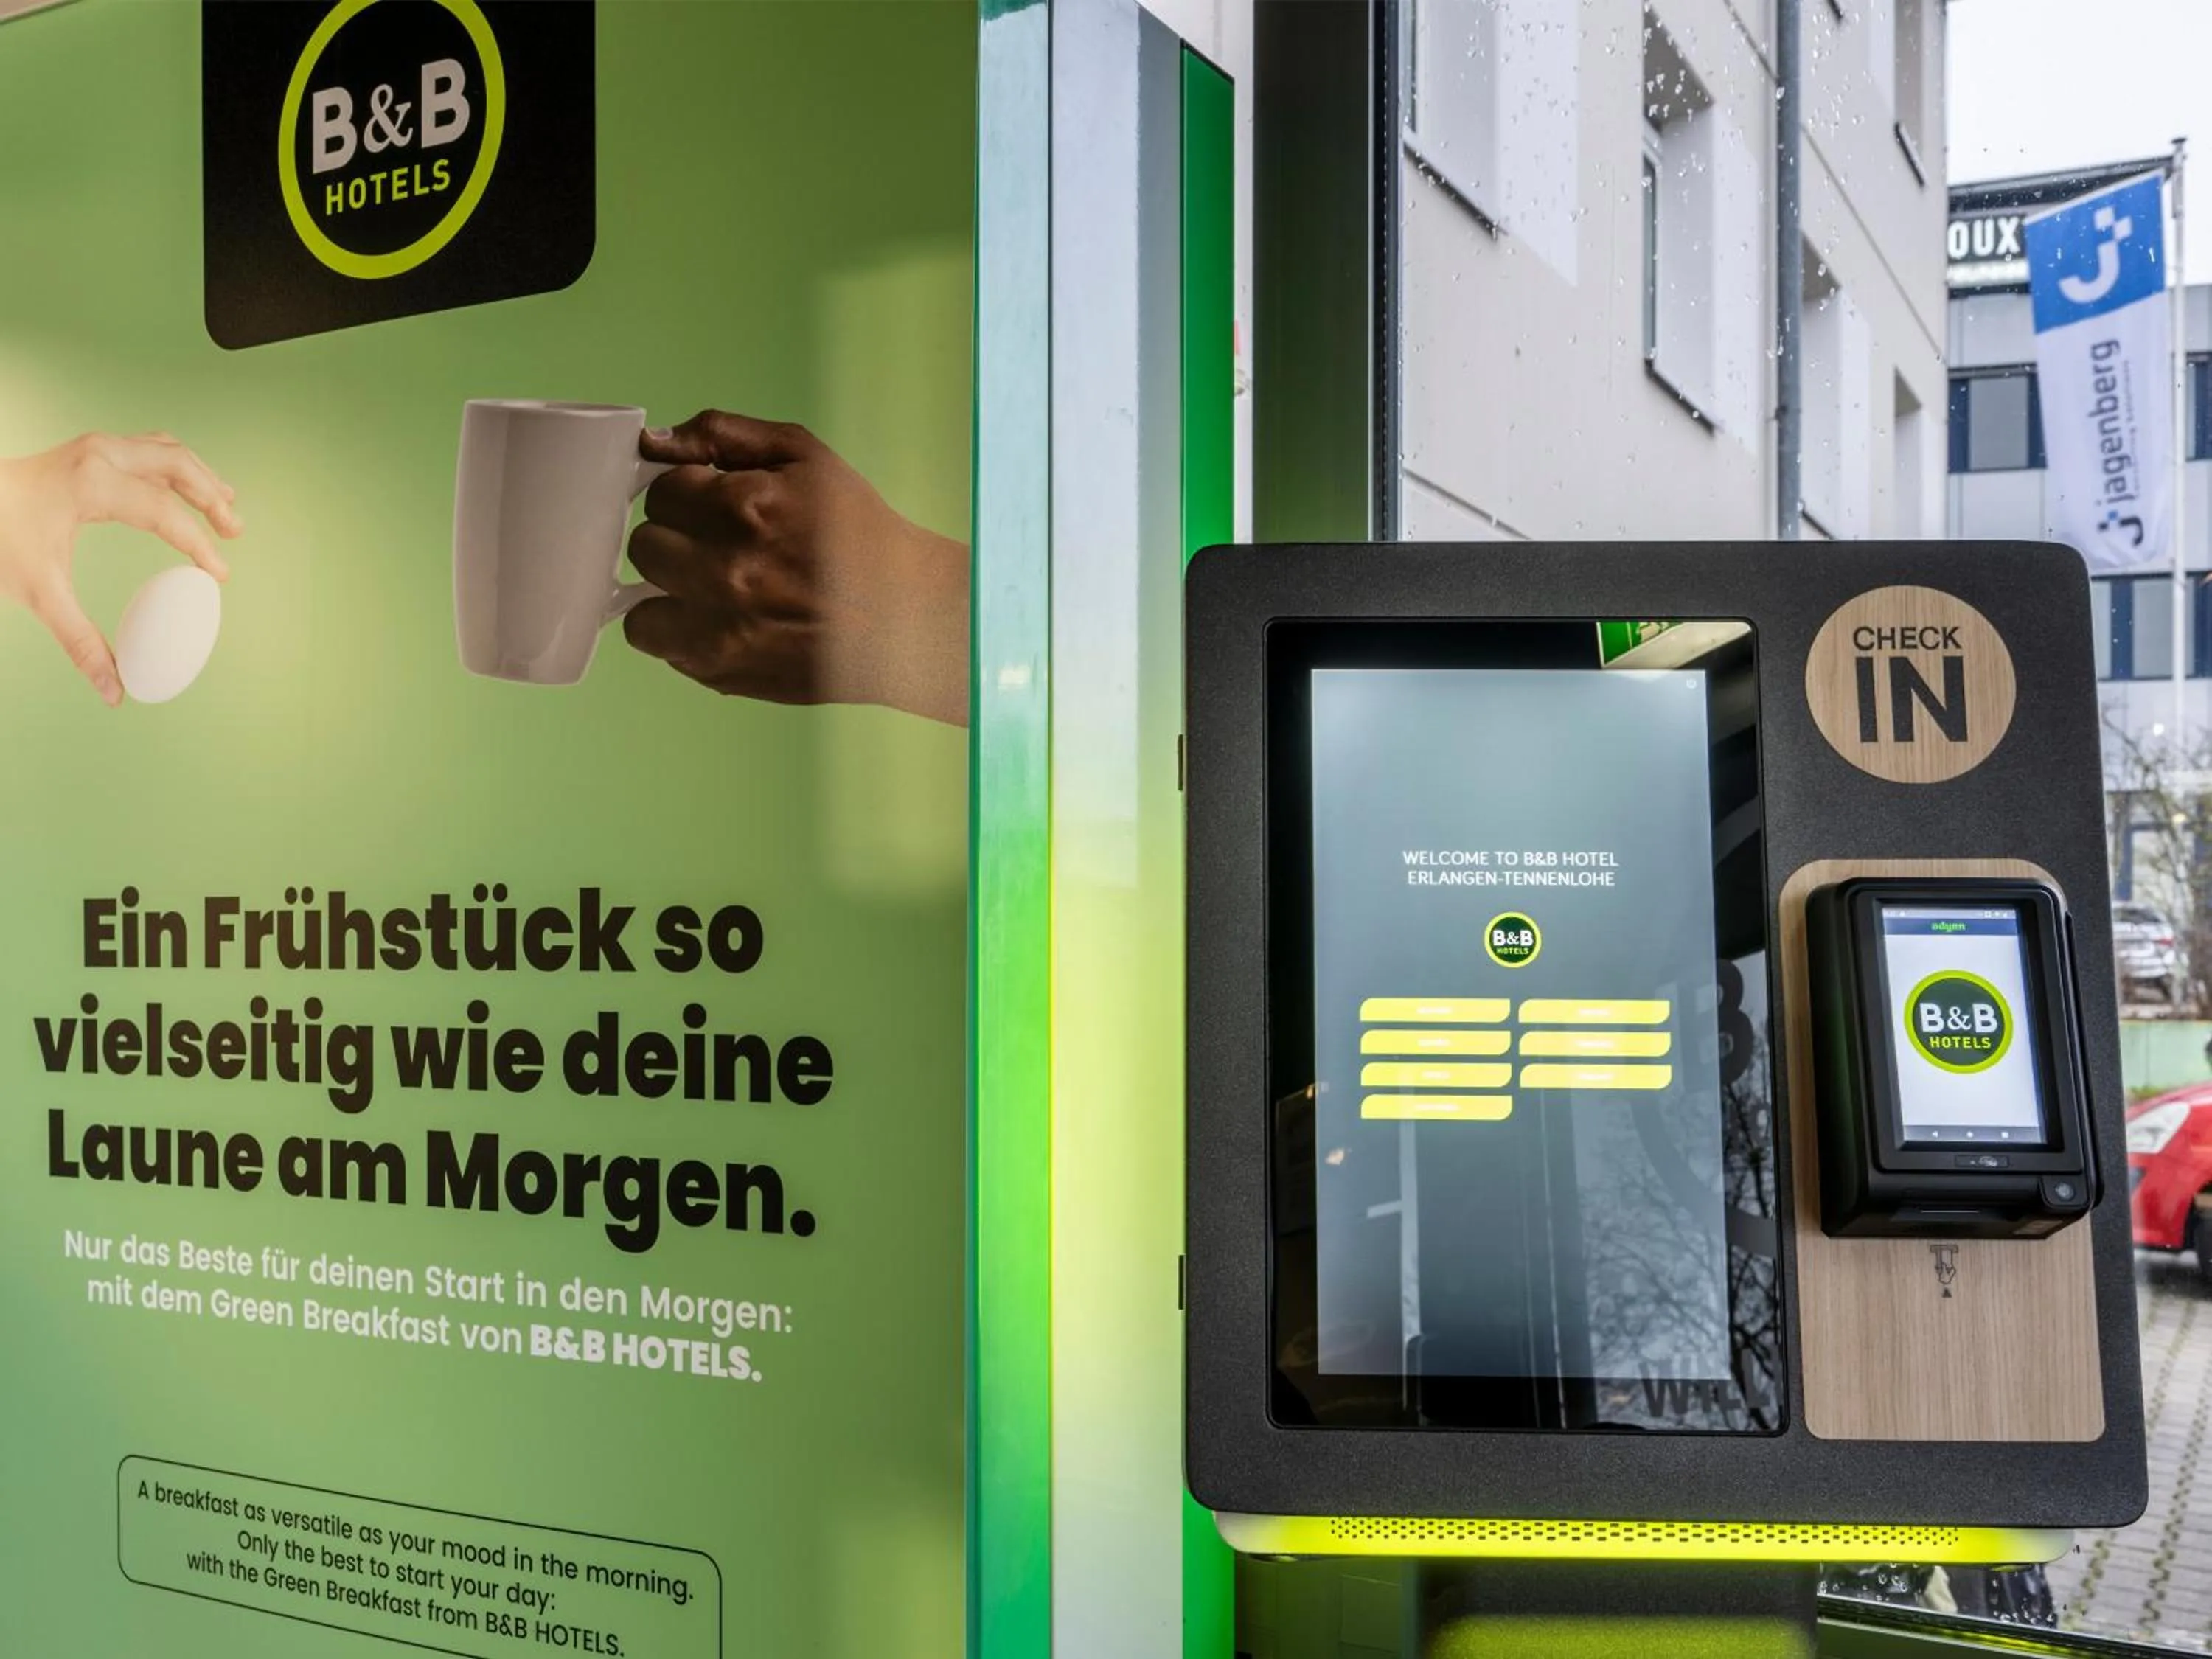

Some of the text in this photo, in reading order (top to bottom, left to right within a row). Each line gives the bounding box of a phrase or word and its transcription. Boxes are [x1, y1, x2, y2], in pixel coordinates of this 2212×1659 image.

[312, 58, 470, 174] B&B
[326, 159, 451, 215] HOTELS
[2087, 339, 2136, 507] jagenberg
[1853, 626, 1962, 651] CHECK
[1855, 655, 1968, 743] IN
[1402, 850, 1619, 867] WELCOME TO B&B HOTEL
[1408, 870, 1615, 886] ERLANGEN-TENNENLOHE
[83, 883, 764, 973] Ein Frühstück so
[1492, 929, 1534, 946] B&B
[33, 992, 834, 1114] vielseitig wie deine
[1919, 1002, 1997, 1033] B&B
[1929, 1036, 1992, 1049] HOTELS
[48, 1108, 816, 1253] Laune am Morgen.
[64, 1230, 793, 1338] Nur das Beste für deinen Start in den Morgen:
[88, 1274, 763, 1382] mit dem Green Breakfast von B&B HOTELS.
[138, 1480, 694, 1605] A breakfast as versatile as your mood in the morning.
[237, 1529, 556, 1615] Only the best to start your day:
[187, 1551, 625, 1657] with the Green Breakfast from B&B HOTELS.
